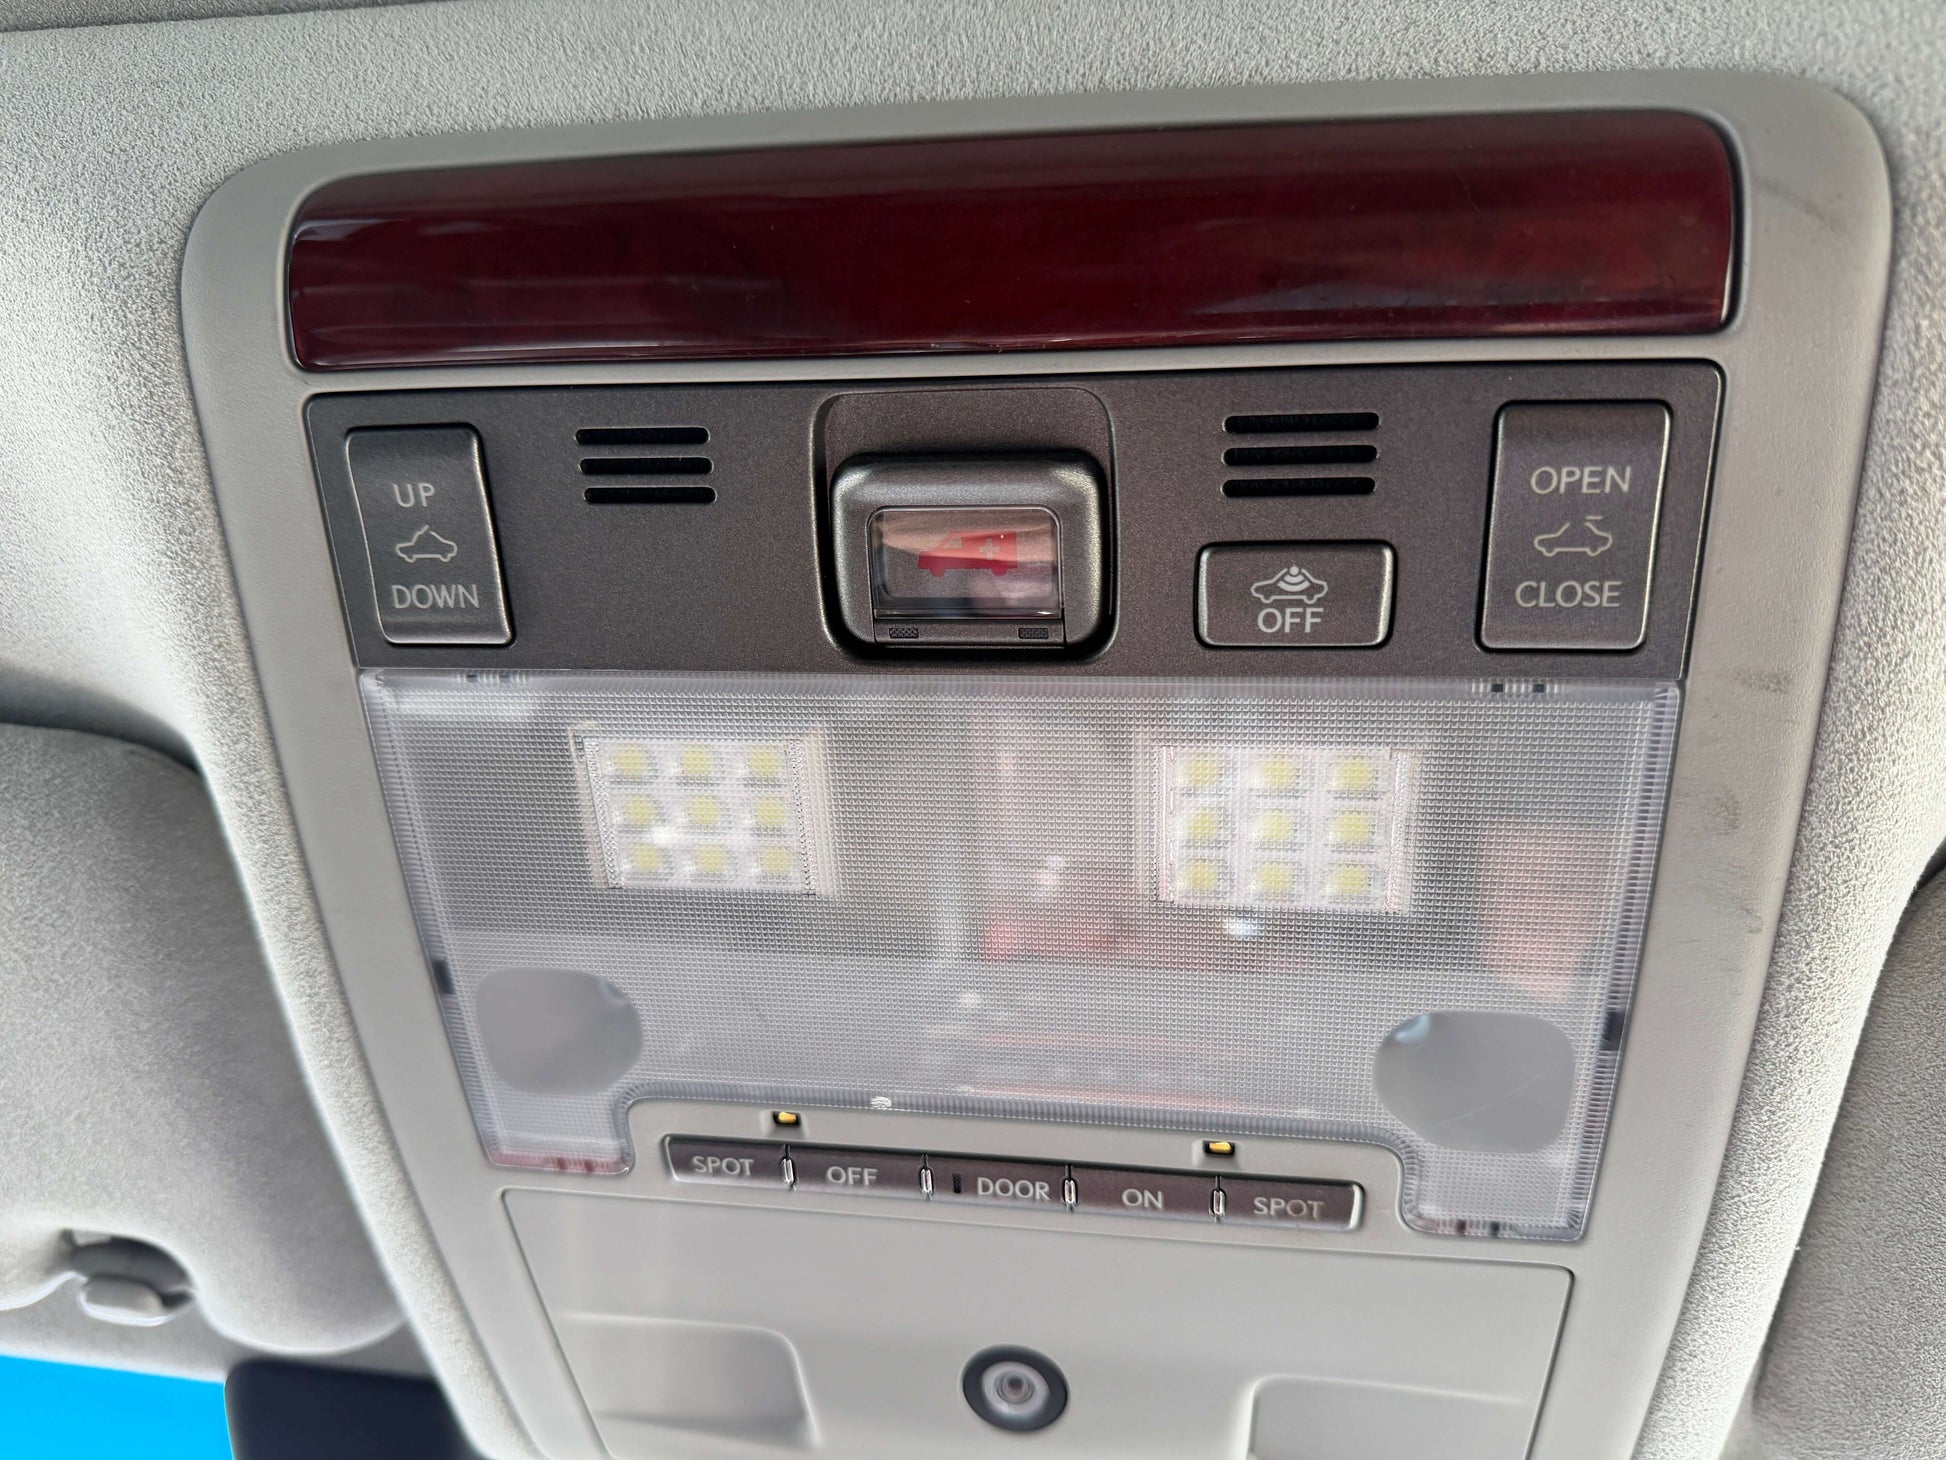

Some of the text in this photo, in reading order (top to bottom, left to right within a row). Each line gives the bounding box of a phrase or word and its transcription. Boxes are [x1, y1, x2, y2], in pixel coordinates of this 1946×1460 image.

[1530, 466, 1632, 494] OPEN
[392, 482, 435, 508] UP
[391, 584, 480, 609] DOWN
[1514, 580, 1622, 608] CLOSE
[1257, 607, 1324, 633] OFF
[692, 1155, 754, 1176] SPOT
[826, 1166, 878, 1186] OFF
[976, 1176, 1051, 1201] DOOR
[1121, 1188, 1164, 1210] ON
[1252, 1196, 1325, 1219] SPOT
